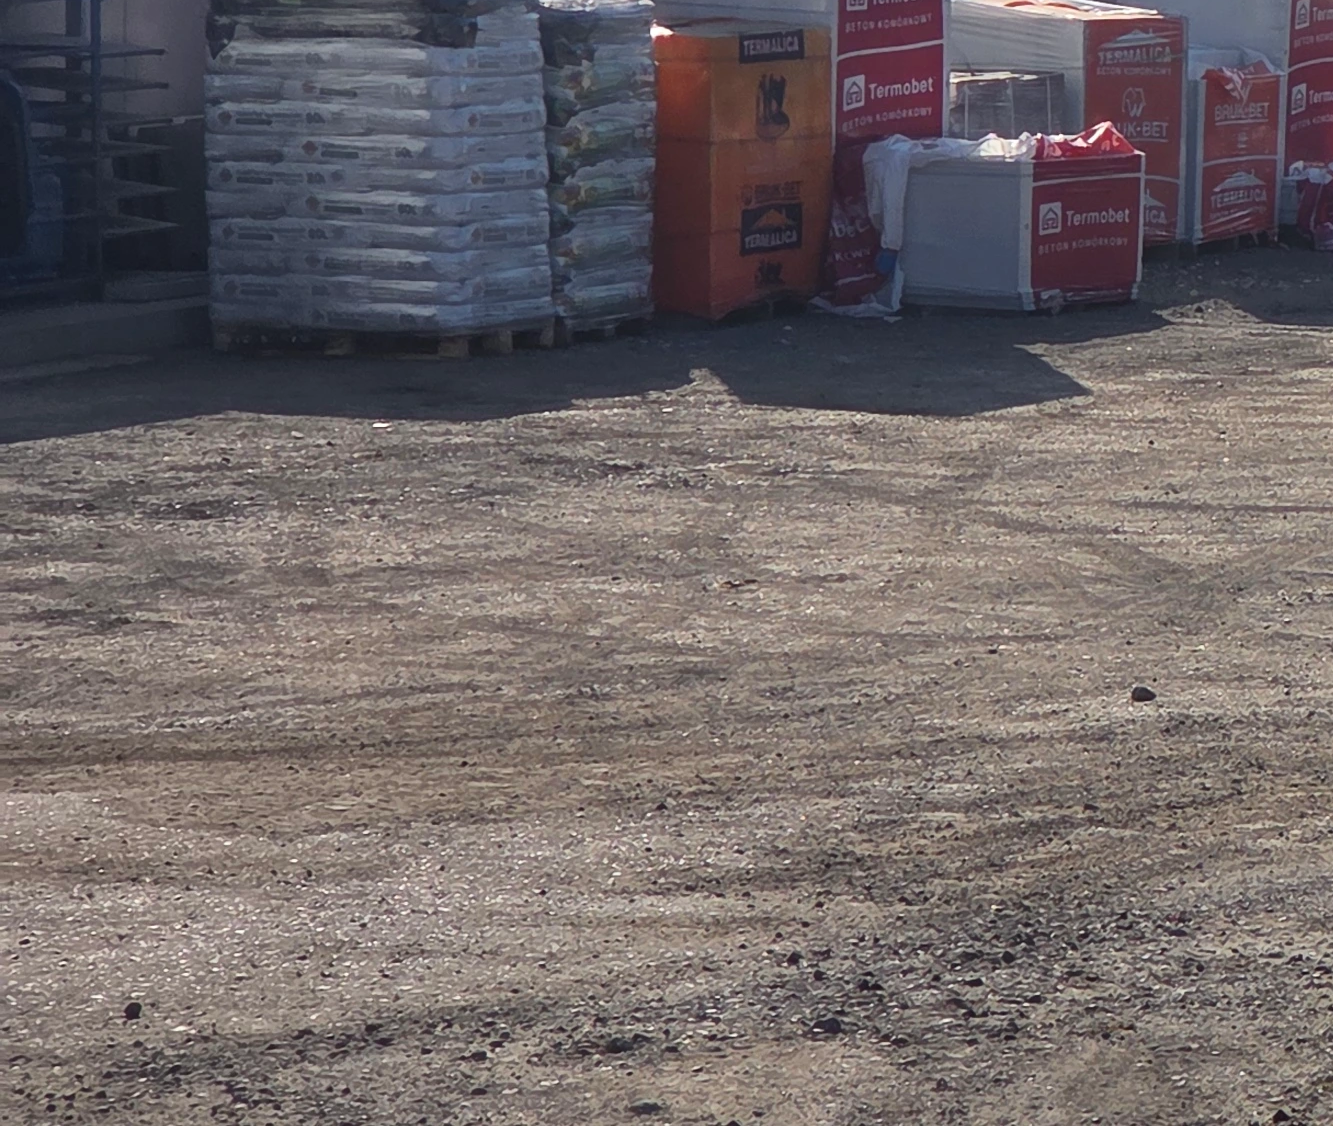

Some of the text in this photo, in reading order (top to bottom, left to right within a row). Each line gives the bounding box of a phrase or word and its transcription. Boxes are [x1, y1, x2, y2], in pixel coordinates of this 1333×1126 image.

[1097, 46, 1172, 65] TERMALICA
[868, 76, 934, 100] Termobet
[1065, 207, 1130, 227] Termobet
